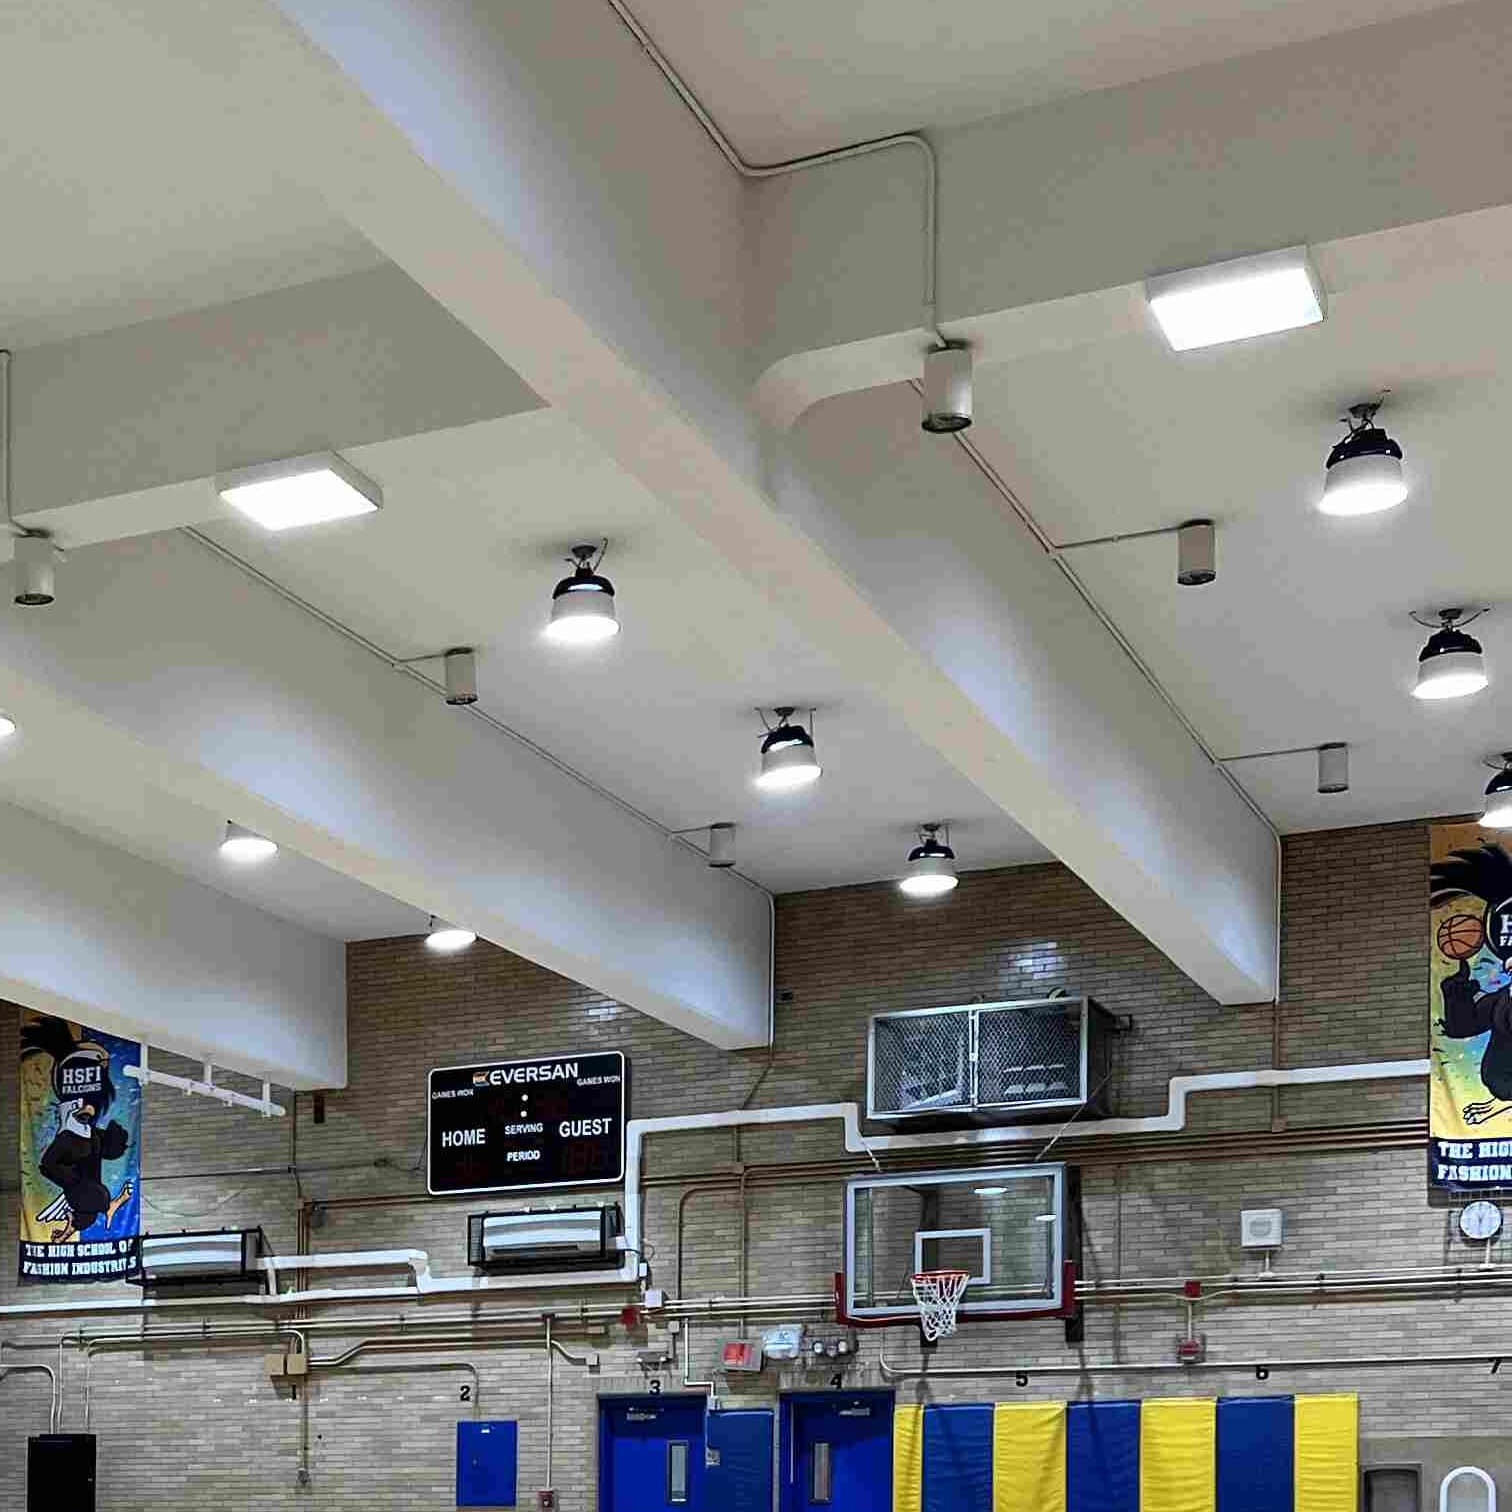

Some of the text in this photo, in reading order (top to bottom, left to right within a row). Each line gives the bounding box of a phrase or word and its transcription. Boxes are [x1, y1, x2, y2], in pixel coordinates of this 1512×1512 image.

[63, 1066, 101, 1085] HSFI
[489, 1062, 578, 1085] EVERSAN
[62, 1082, 102, 1094] FALCONS
[504, 1122, 544, 1135] SERVING
[559, 1118, 612, 1138] GUEST
[442, 1128, 486, 1148] HOME
[506, 1150, 541, 1162] PERIOD
[1437, 1141, 1512, 1158] THE HIG
[47, 1244, 75, 1257] HIGH
[77, 1241, 117, 1257] SCHOOL
[22, 1260, 69, 1276] FASHION
[829, 1373, 843, 1389] 4
[1015, 1370, 1029, 1387] 5
[1255, 1364, 1270, 1381] 6
[459, 1385, 472, 1401] 2
[648, 1379, 662, 1396] 3
